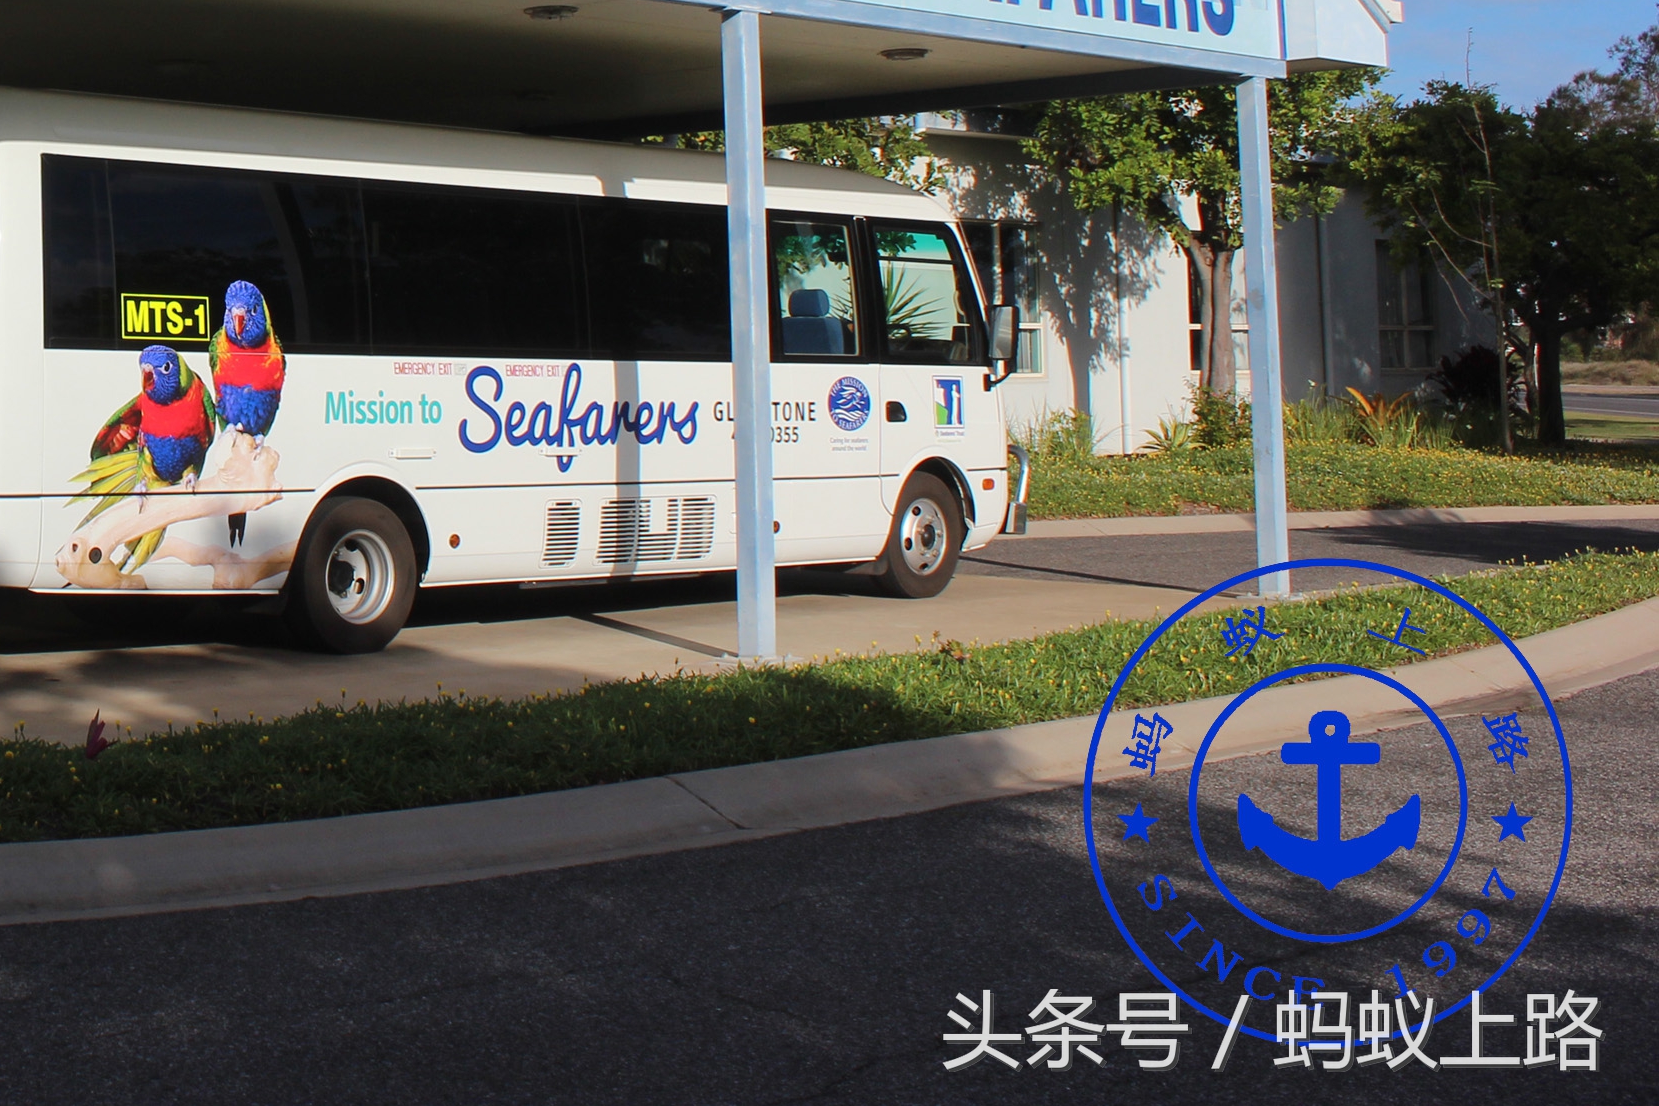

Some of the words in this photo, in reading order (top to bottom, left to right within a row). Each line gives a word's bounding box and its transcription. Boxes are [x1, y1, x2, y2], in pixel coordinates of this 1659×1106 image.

[126, 300, 206, 335] MTS-1
[394, 361, 436, 375] EMERGENCY
[438, 362, 452, 376] EXIT
[505, 364, 544, 376] EMERGENCY
[547, 364, 560, 377] EXIT
[325, 390, 413, 424] Mission
[419, 394, 443, 424] to
[458, 362, 699, 473] Seafarers
